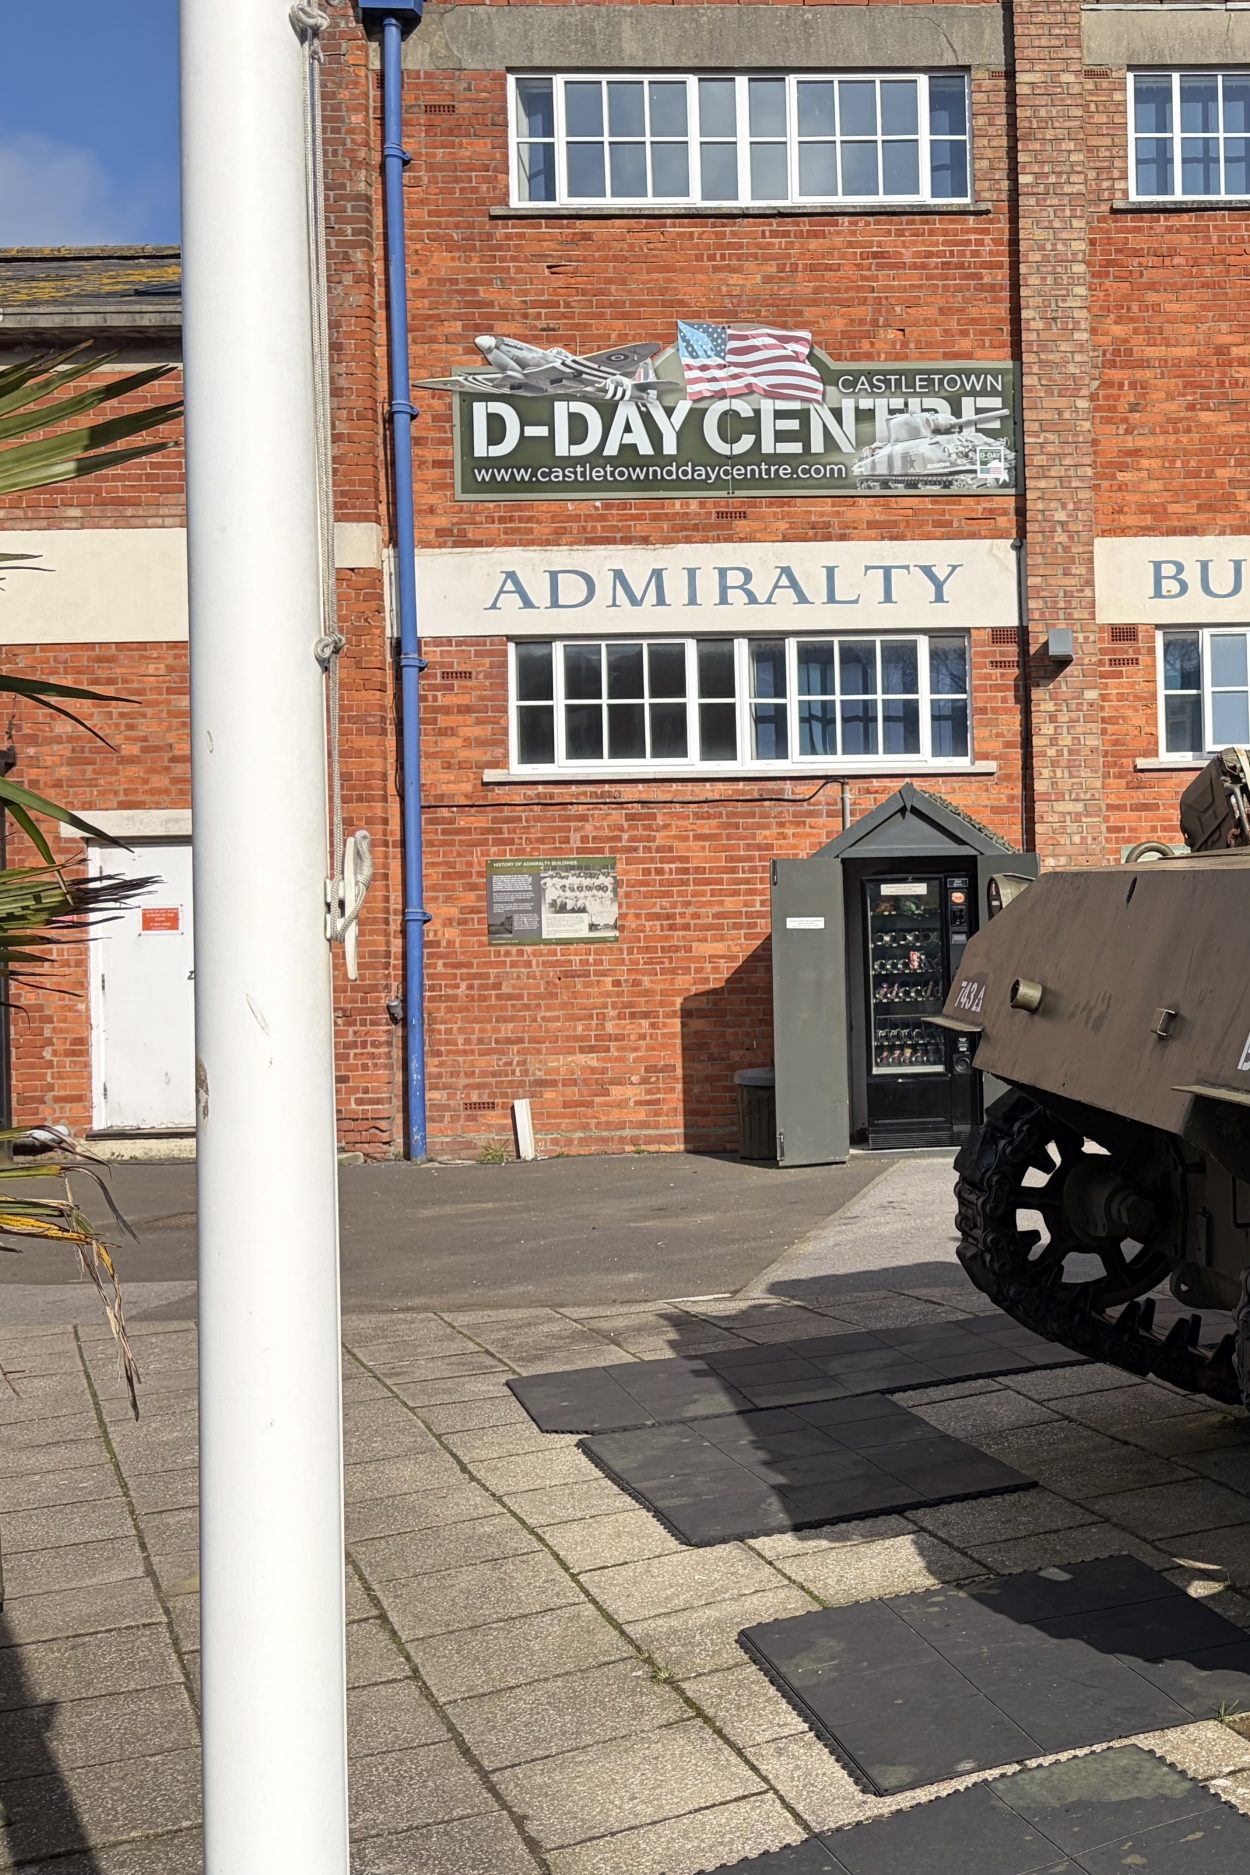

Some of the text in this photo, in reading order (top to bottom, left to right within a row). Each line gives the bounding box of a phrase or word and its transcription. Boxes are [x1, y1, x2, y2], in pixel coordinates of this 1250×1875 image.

[838, 374, 1003, 394] CASTLETOWN
[472, 400, 693, 458] D-DAY
[473, 461, 847, 484] www.castletownddaycentre.com
[482, 563, 965, 611] ADMIRALTY
